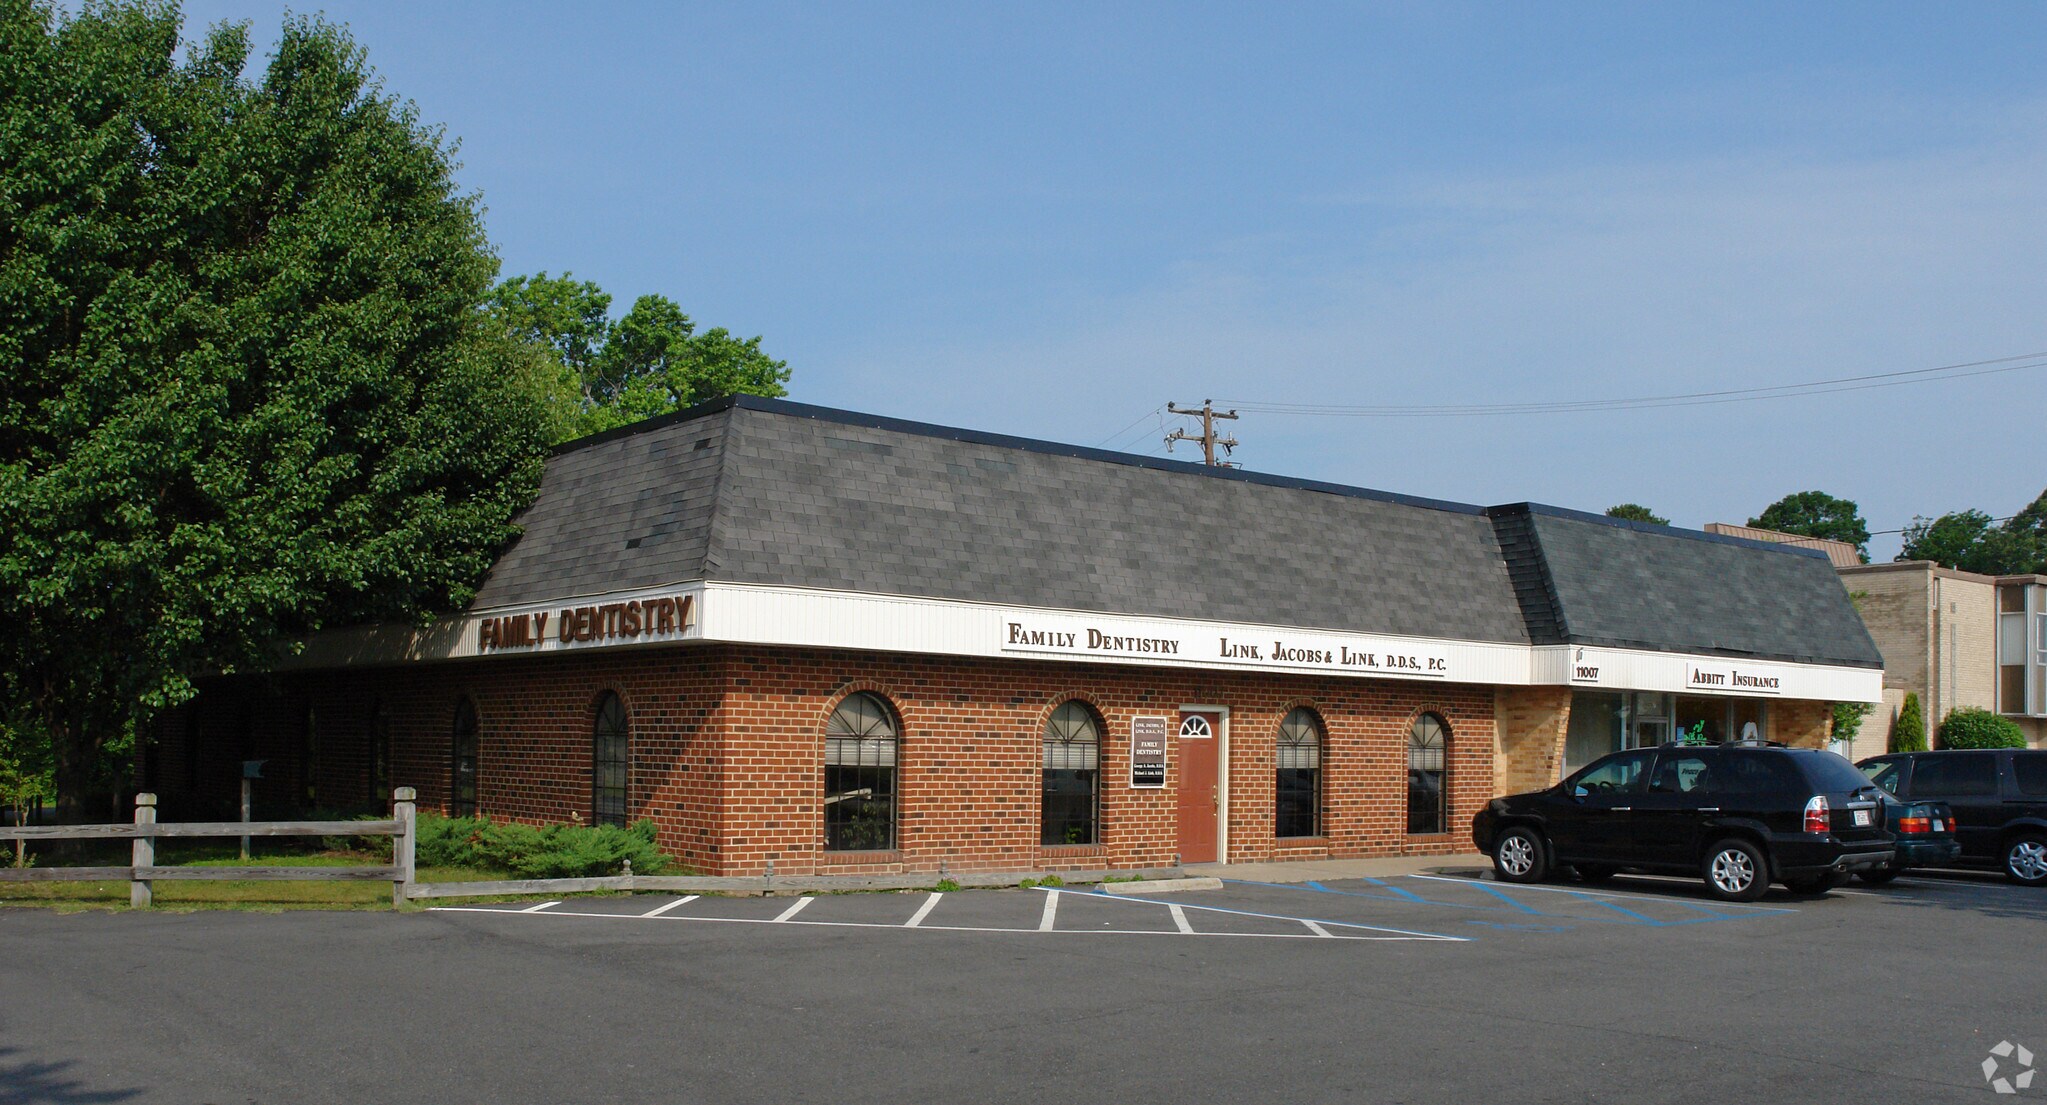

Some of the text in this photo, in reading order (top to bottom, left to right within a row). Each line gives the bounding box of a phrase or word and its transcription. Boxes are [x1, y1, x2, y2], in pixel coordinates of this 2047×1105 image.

[480, 595, 694, 650] FAMILY DENTISTRY
[1008, 622, 1179, 654] FAMILY DENTISTRY
[1219, 637, 1264, 662] LINK,
[1340, 646, 1379, 669] LINK,
[1428, 657, 1447, 671] P.C.
[1576, 666, 1599, 679] 11007
[1692, 667, 1780, 689] ABBITT INSURANCE
